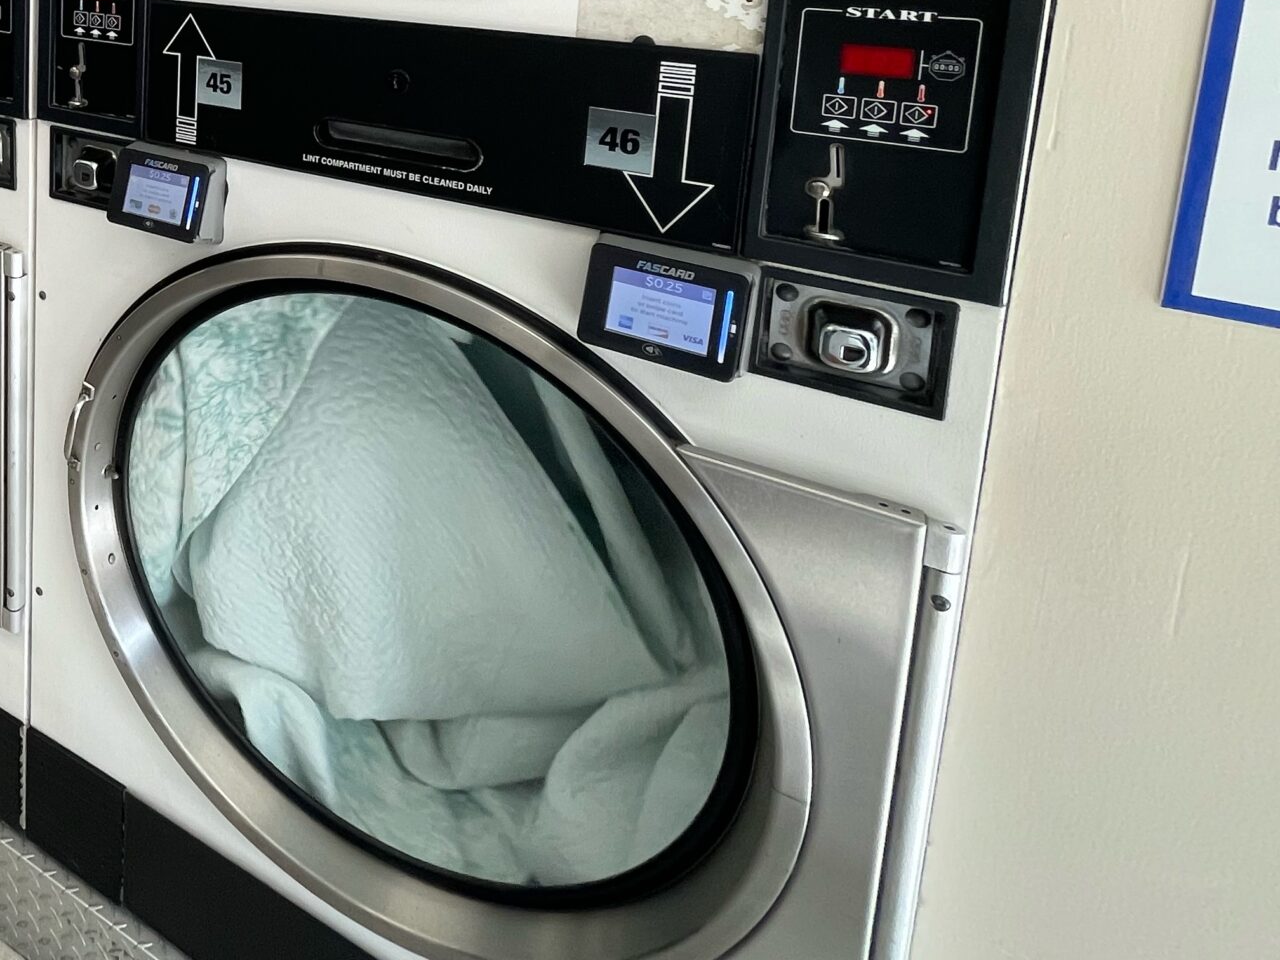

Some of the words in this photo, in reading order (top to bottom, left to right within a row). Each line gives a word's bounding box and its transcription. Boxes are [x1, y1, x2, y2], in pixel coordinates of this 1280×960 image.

[845, 6, 938, 23] START
[205, 72, 232, 95] 45
[598, 126, 640, 155] 46
[144, 159, 179, 172] FASCARD
[302, 153, 320, 164] LINT
[320, 156, 382, 175] COMPARTMENT
[383, 168, 407, 179] MUST
[408, 172, 421, 182] BE
[422, 175, 465, 190] CLEANED
[466, 183, 493, 195] DAILY
[636, 259, 696, 281] FASCARD
[683, 334, 704, 346] VISA
